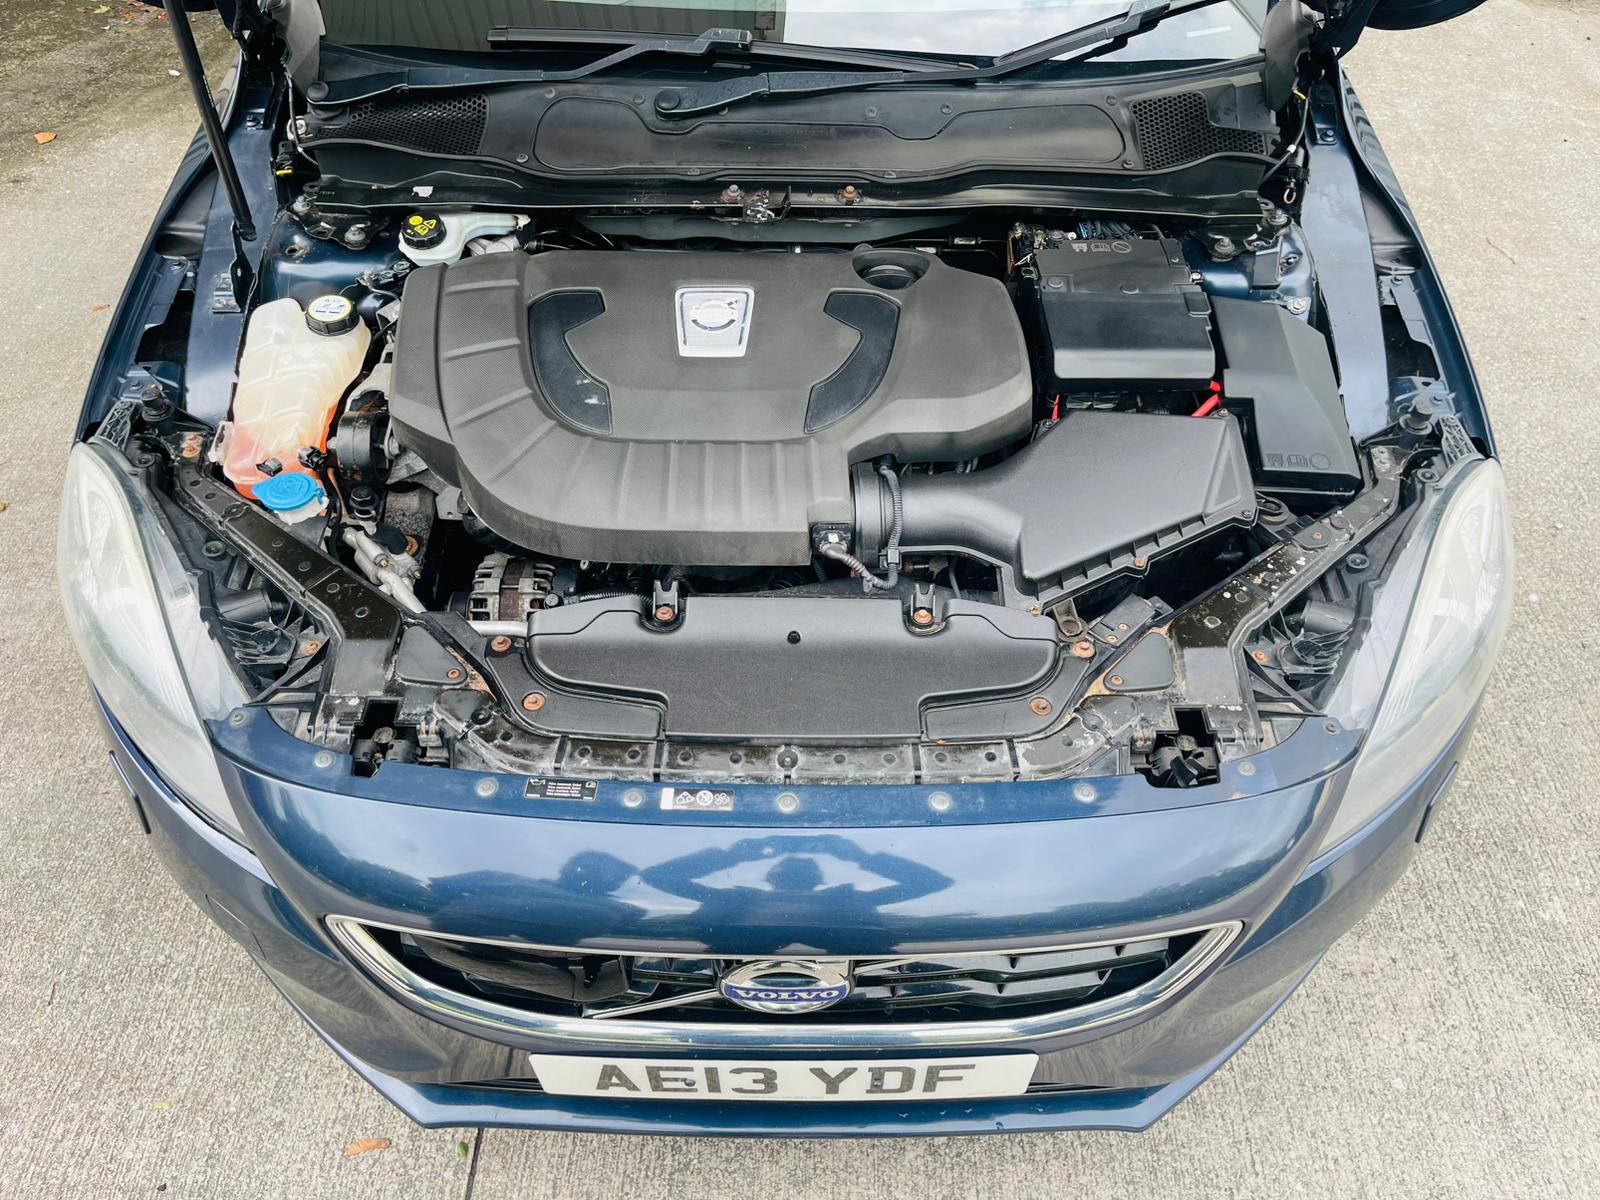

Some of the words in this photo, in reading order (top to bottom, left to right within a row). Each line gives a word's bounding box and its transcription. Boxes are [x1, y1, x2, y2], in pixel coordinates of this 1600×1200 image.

[732, 989, 839, 1000] VOLVO
[596, 1065, 777, 1094] AE13
[809, 1064, 976, 1094] YDF
